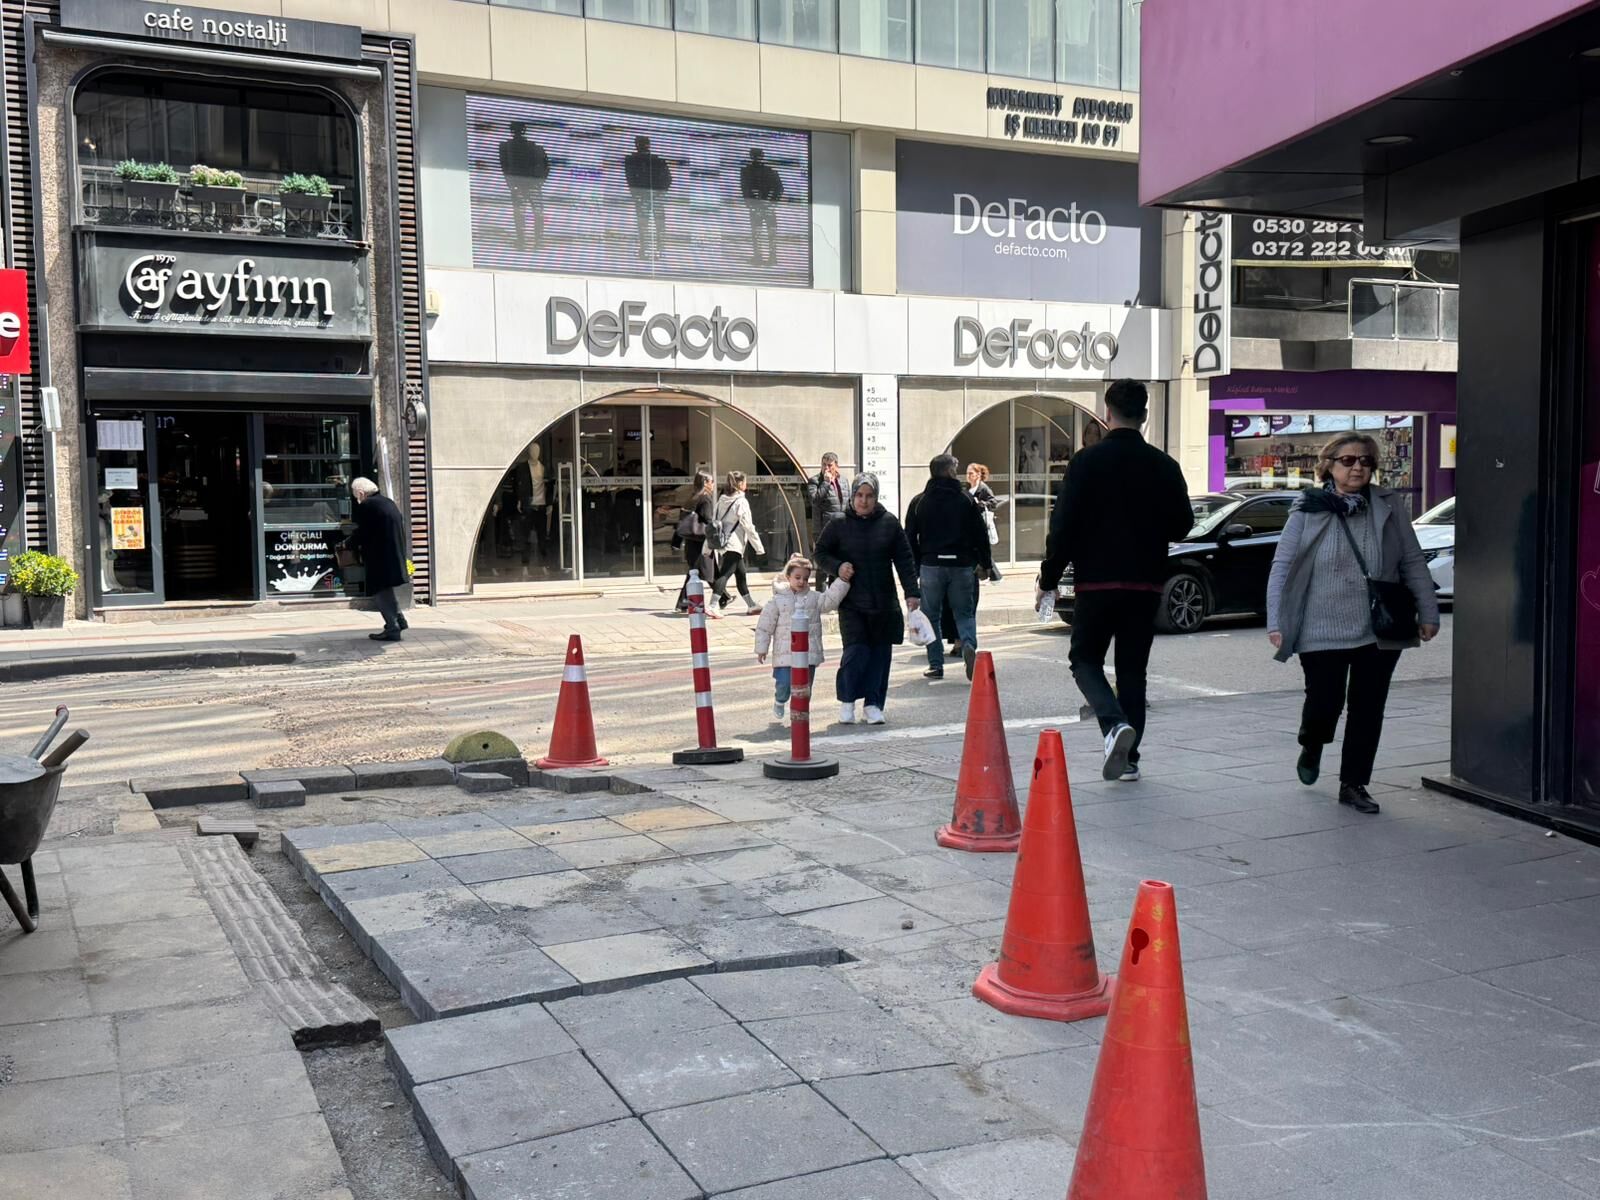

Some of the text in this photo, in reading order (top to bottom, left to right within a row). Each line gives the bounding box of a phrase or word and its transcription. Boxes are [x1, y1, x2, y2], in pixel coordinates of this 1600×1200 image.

[144, 9, 288, 46] cafe nostalji
[953, 194, 1107, 245] DeFacto
[1252, 218, 1305, 234] 0530
[1312, 220, 1352, 233] 282
[994, 241, 1068, 259] defacto.com
[1252, 241, 1304, 256] 0372
[1310, 241, 1351, 256] 222
[155, 254, 177, 264] 1970
[546, 296, 758, 361] DeFacto
[954, 316, 1118, 369] DeFacto
[274, 543, 328, 551] DONDURMA
